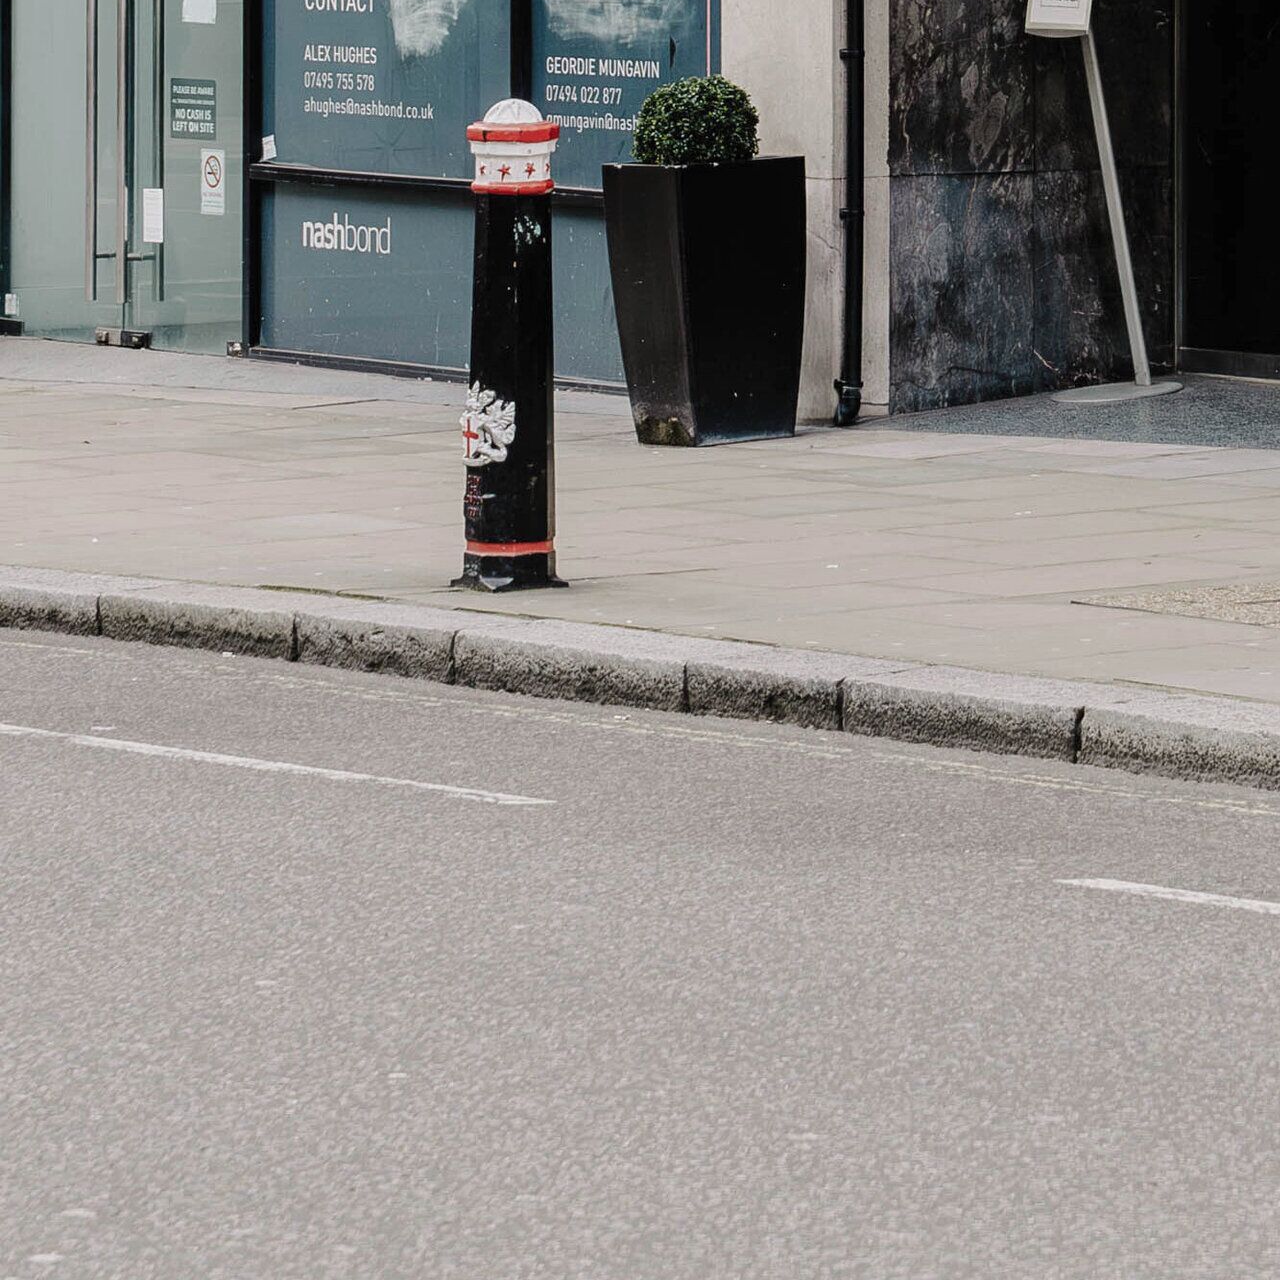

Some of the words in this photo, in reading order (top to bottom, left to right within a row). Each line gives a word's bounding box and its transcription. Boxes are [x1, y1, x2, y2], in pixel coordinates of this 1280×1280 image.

[304, 44, 331, 62] ALEX
[333, 46, 377, 64] HUGHES
[546, 56, 596, 75] GEORDIE
[599, 59, 660, 79] MUNGAVIN
[304, 72, 334, 89] 07495
[336, 73, 354, 90] 755
[356, 74, 375, 91] 578
[546, 84, 577, 103] 07494
[581, 86, 600, 104] 022
[602, 87, 622, 105] 877
[304, 97, 434, 120] ahughes@nashbond.co.uk
[302, 211, 391, 254] nashbond
